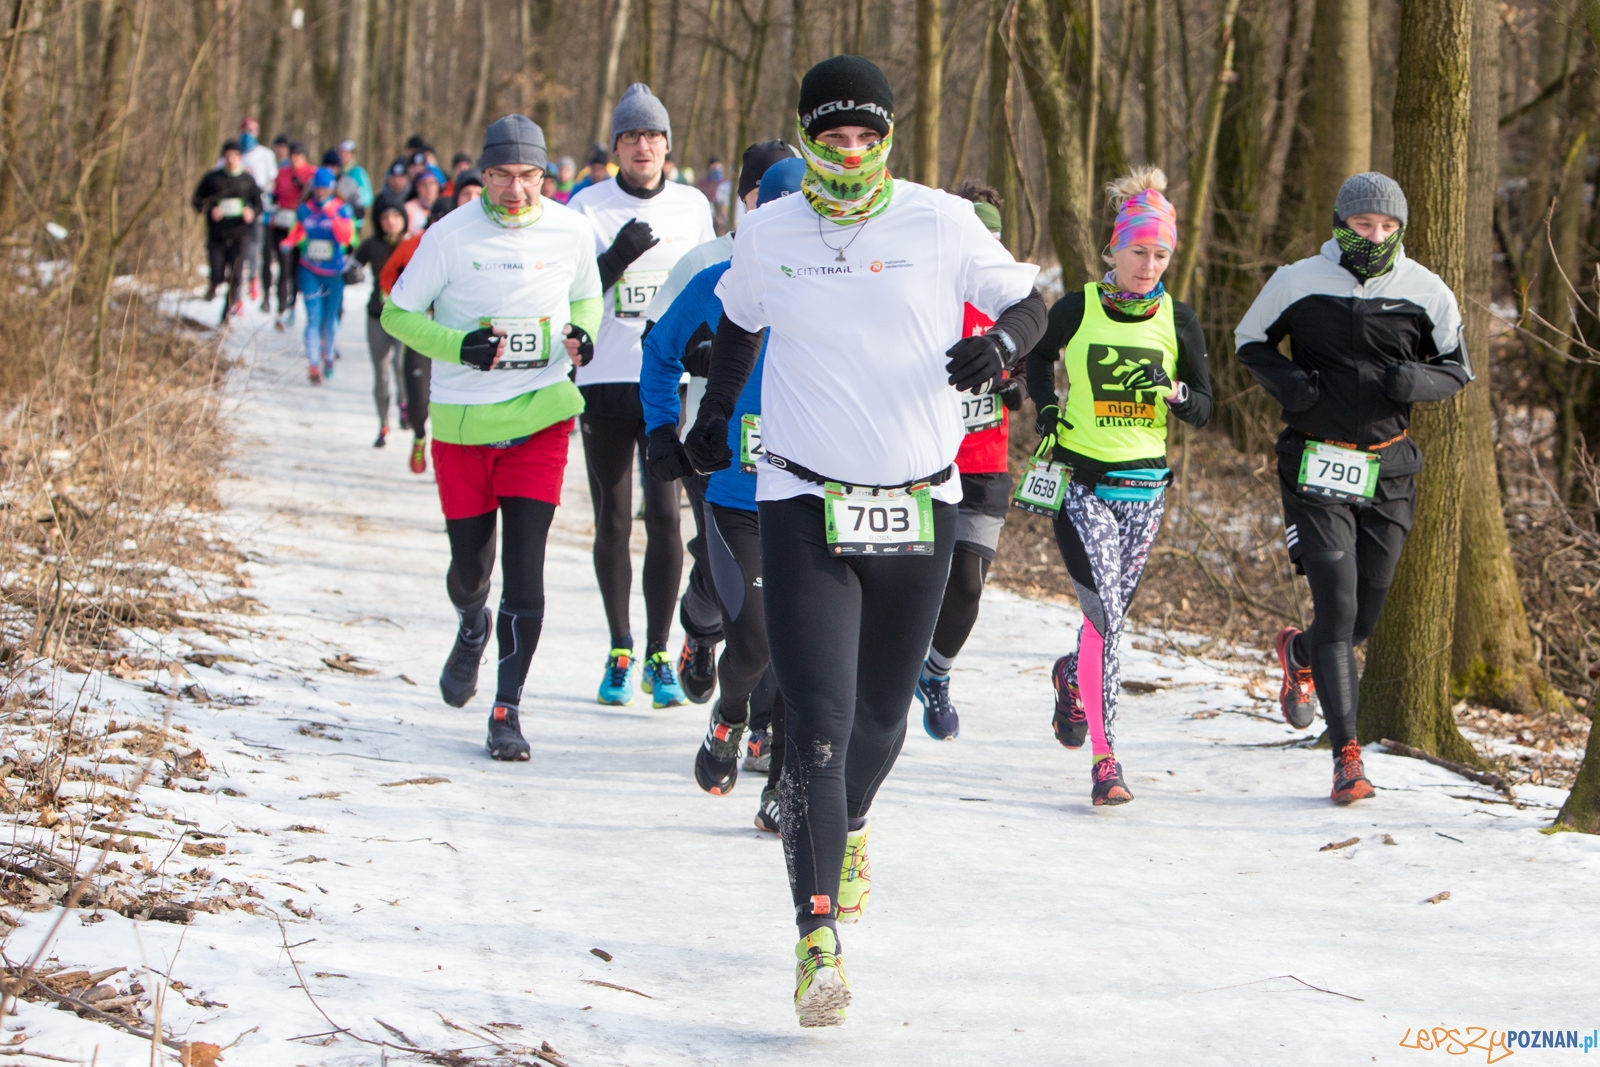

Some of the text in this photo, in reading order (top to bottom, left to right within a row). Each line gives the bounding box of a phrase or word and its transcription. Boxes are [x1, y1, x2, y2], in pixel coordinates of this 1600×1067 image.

[625, 285, 662, 304] 157
[504, 333, 537, 353] 63
[1108, 402, 1147, 417] night
[1318, 459, 1362, 485] 790
[1027, 475, 1057, 499] 1638
[847, 505, 910, 532] 703
